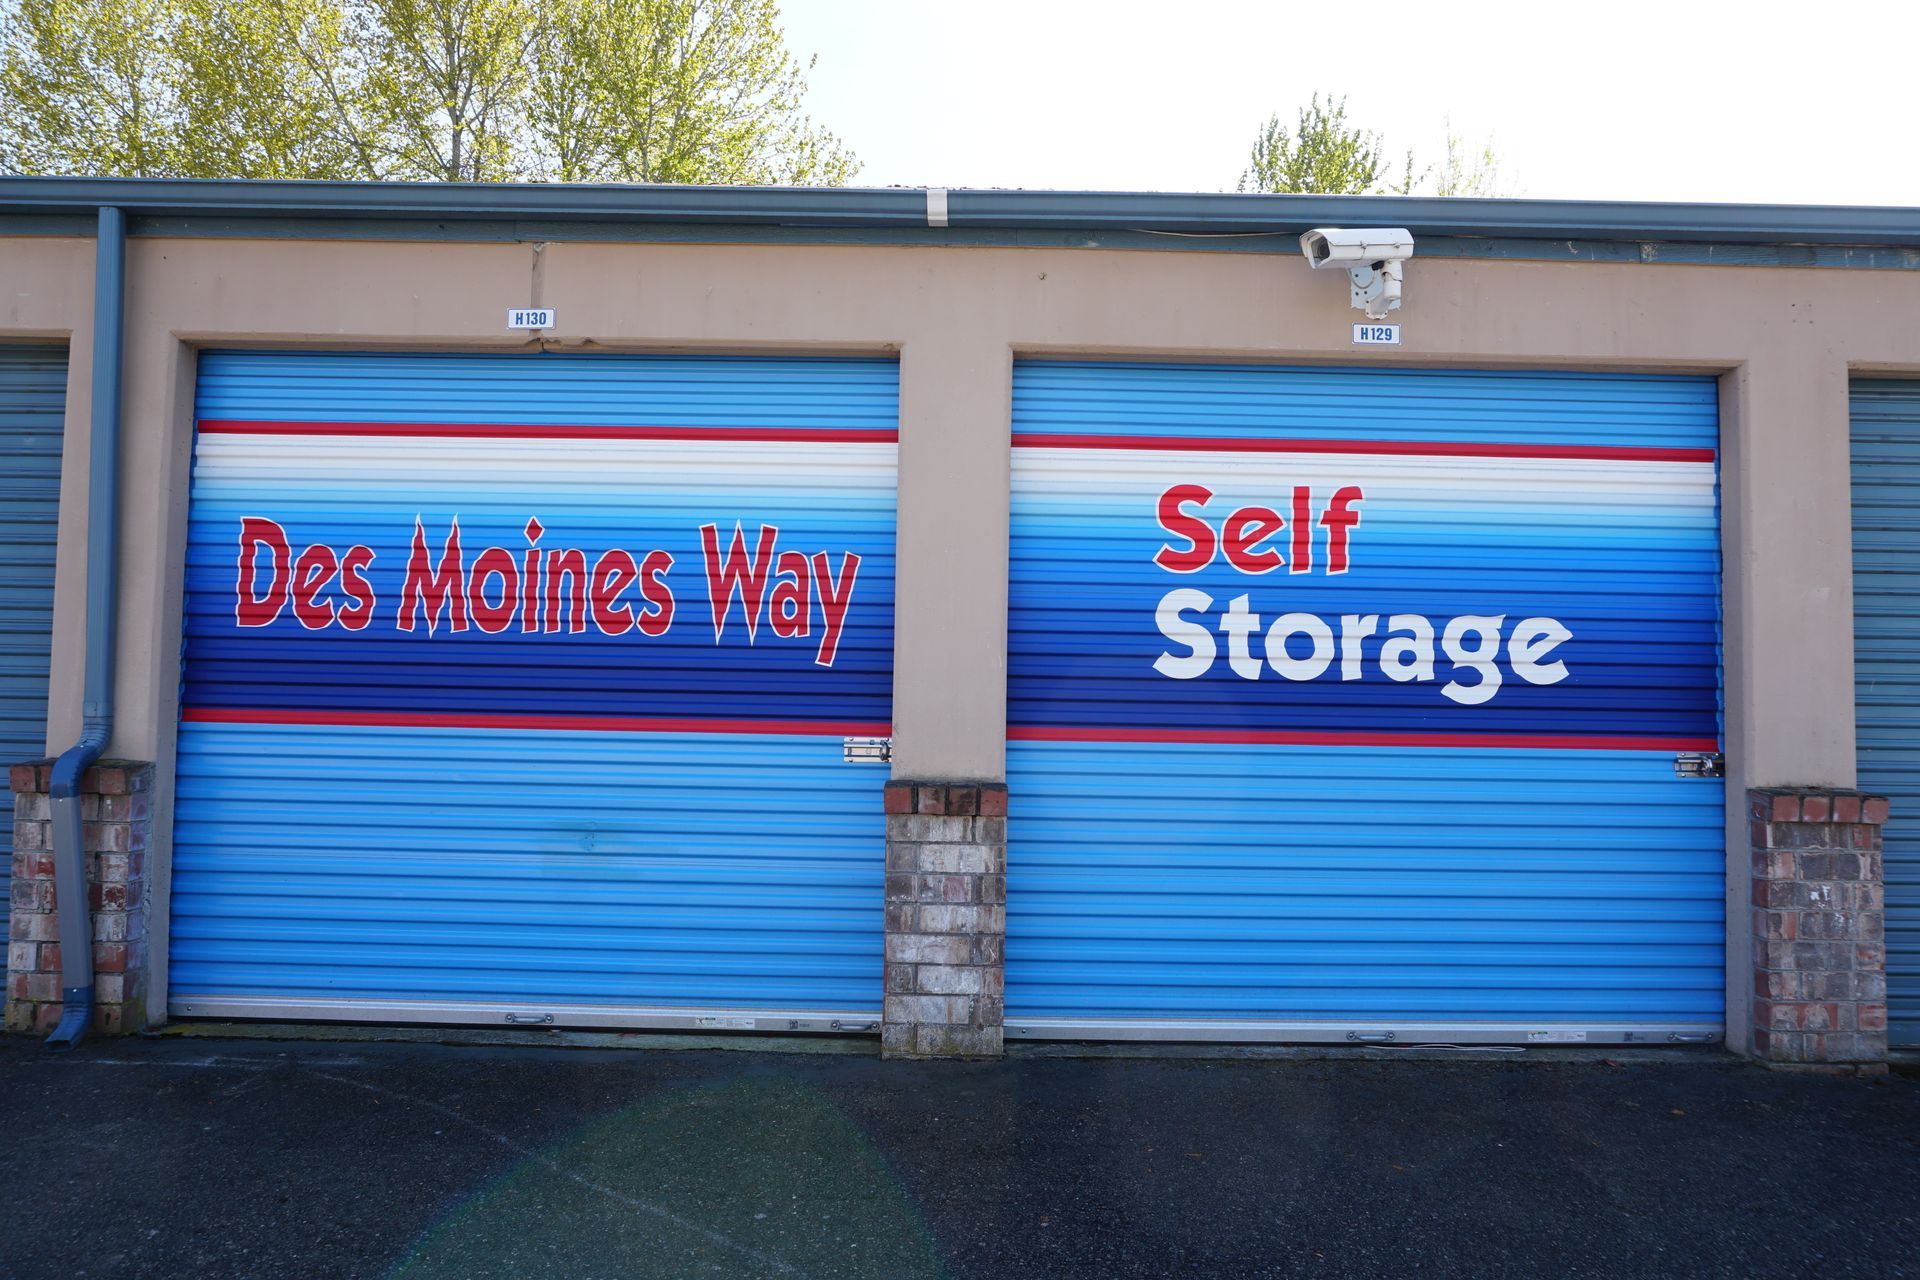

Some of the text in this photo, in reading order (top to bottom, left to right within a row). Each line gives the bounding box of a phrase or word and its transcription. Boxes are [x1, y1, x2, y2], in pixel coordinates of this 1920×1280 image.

[1151, 483, 1366, 576] Self
[236, 511, 862, 667] Des Moines Way
[1152, 588, 1574, 705] Storage
